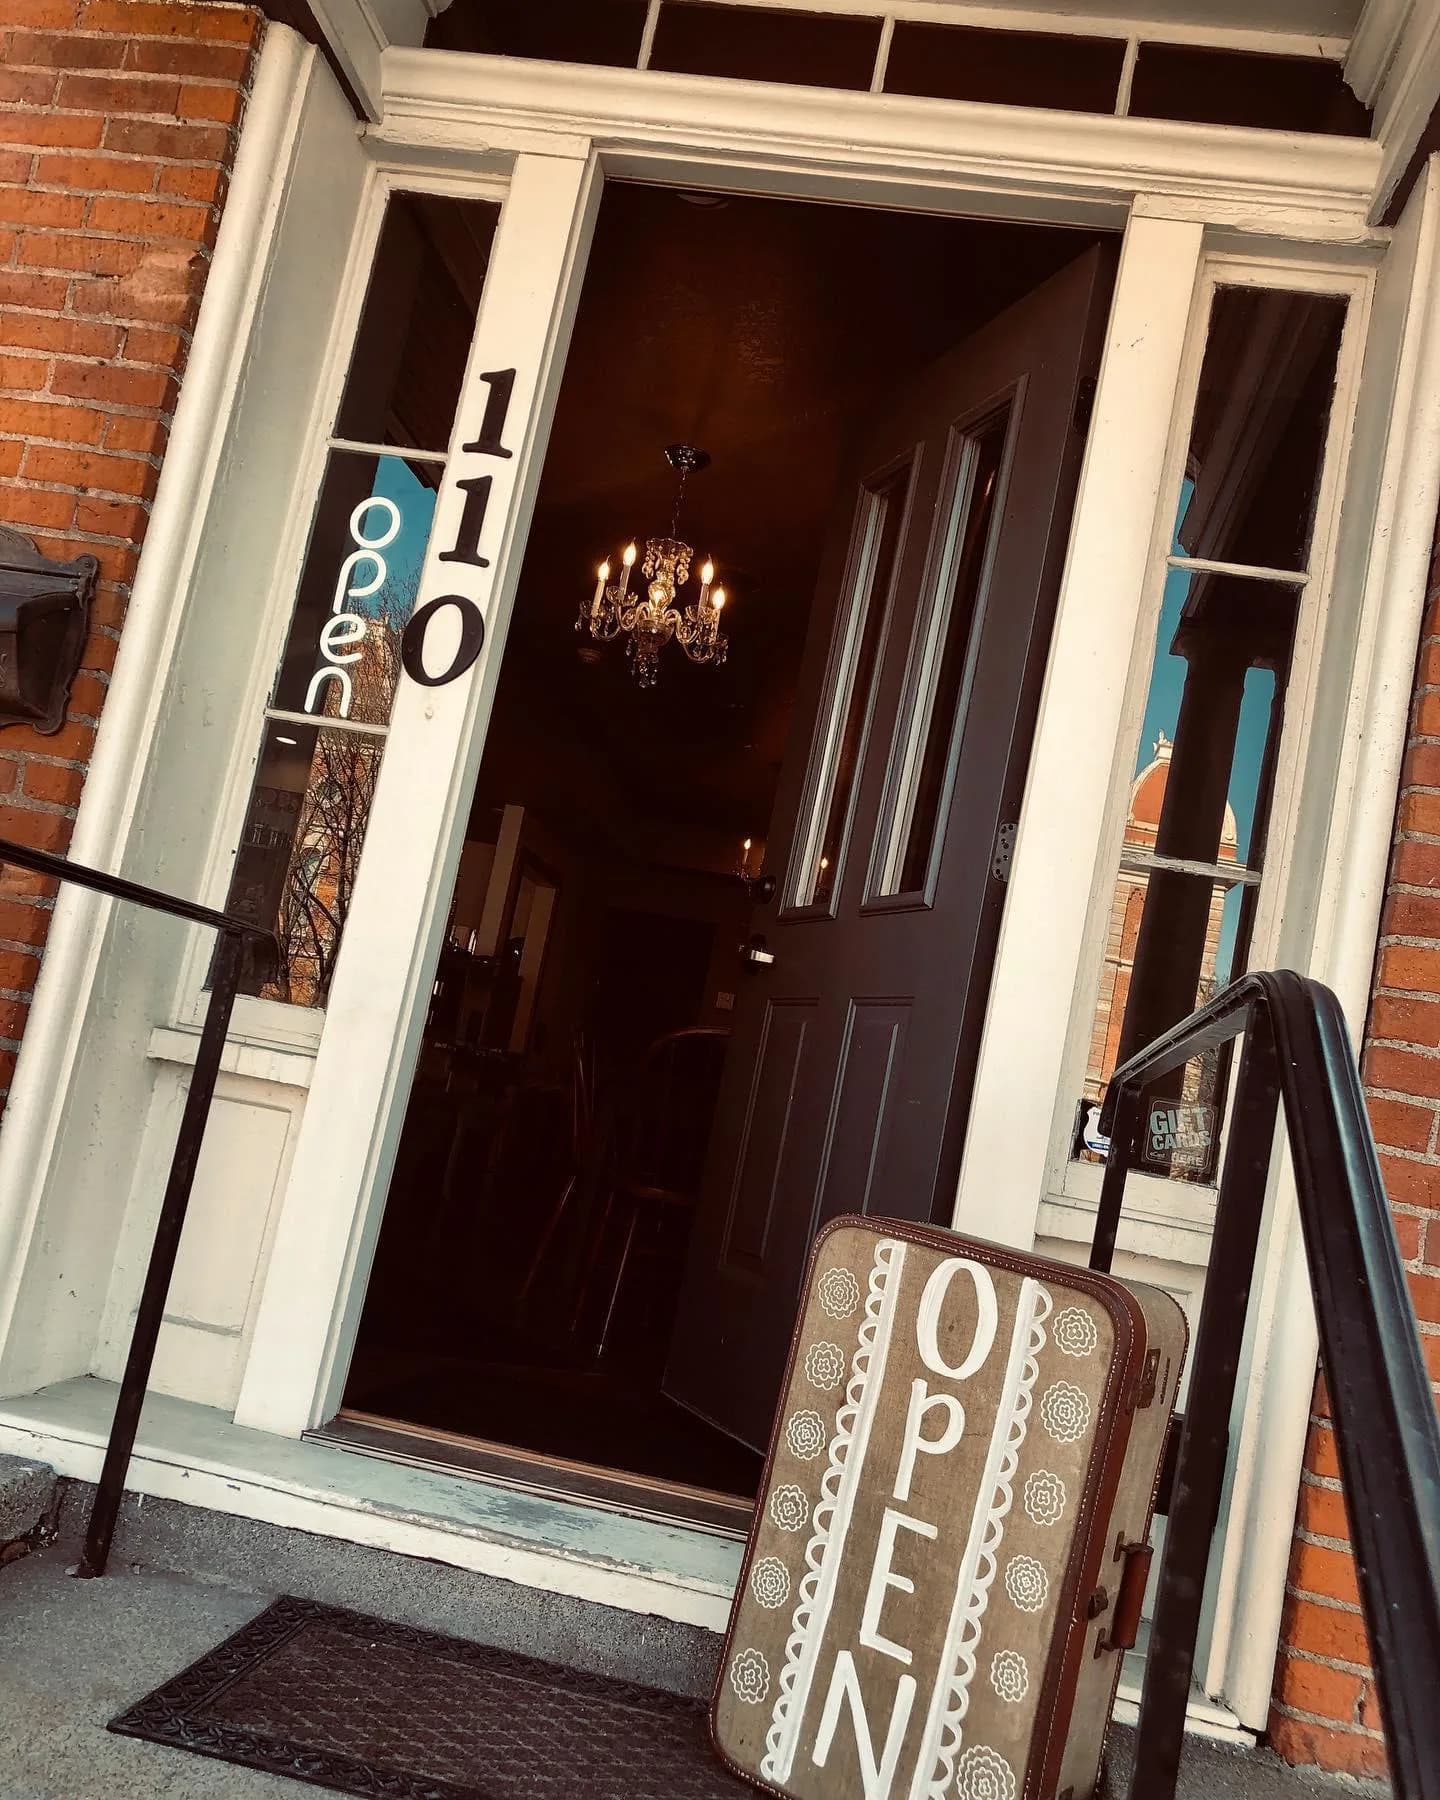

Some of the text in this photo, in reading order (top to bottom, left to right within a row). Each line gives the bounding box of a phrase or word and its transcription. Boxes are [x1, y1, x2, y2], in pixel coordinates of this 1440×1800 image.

[402, 367, 516, 687] 110
[304, 496, 401, 718] open
[1150, 1107, 1208, 1135] GIFT
[1152, 1130, 1211, 1150] CARDS
